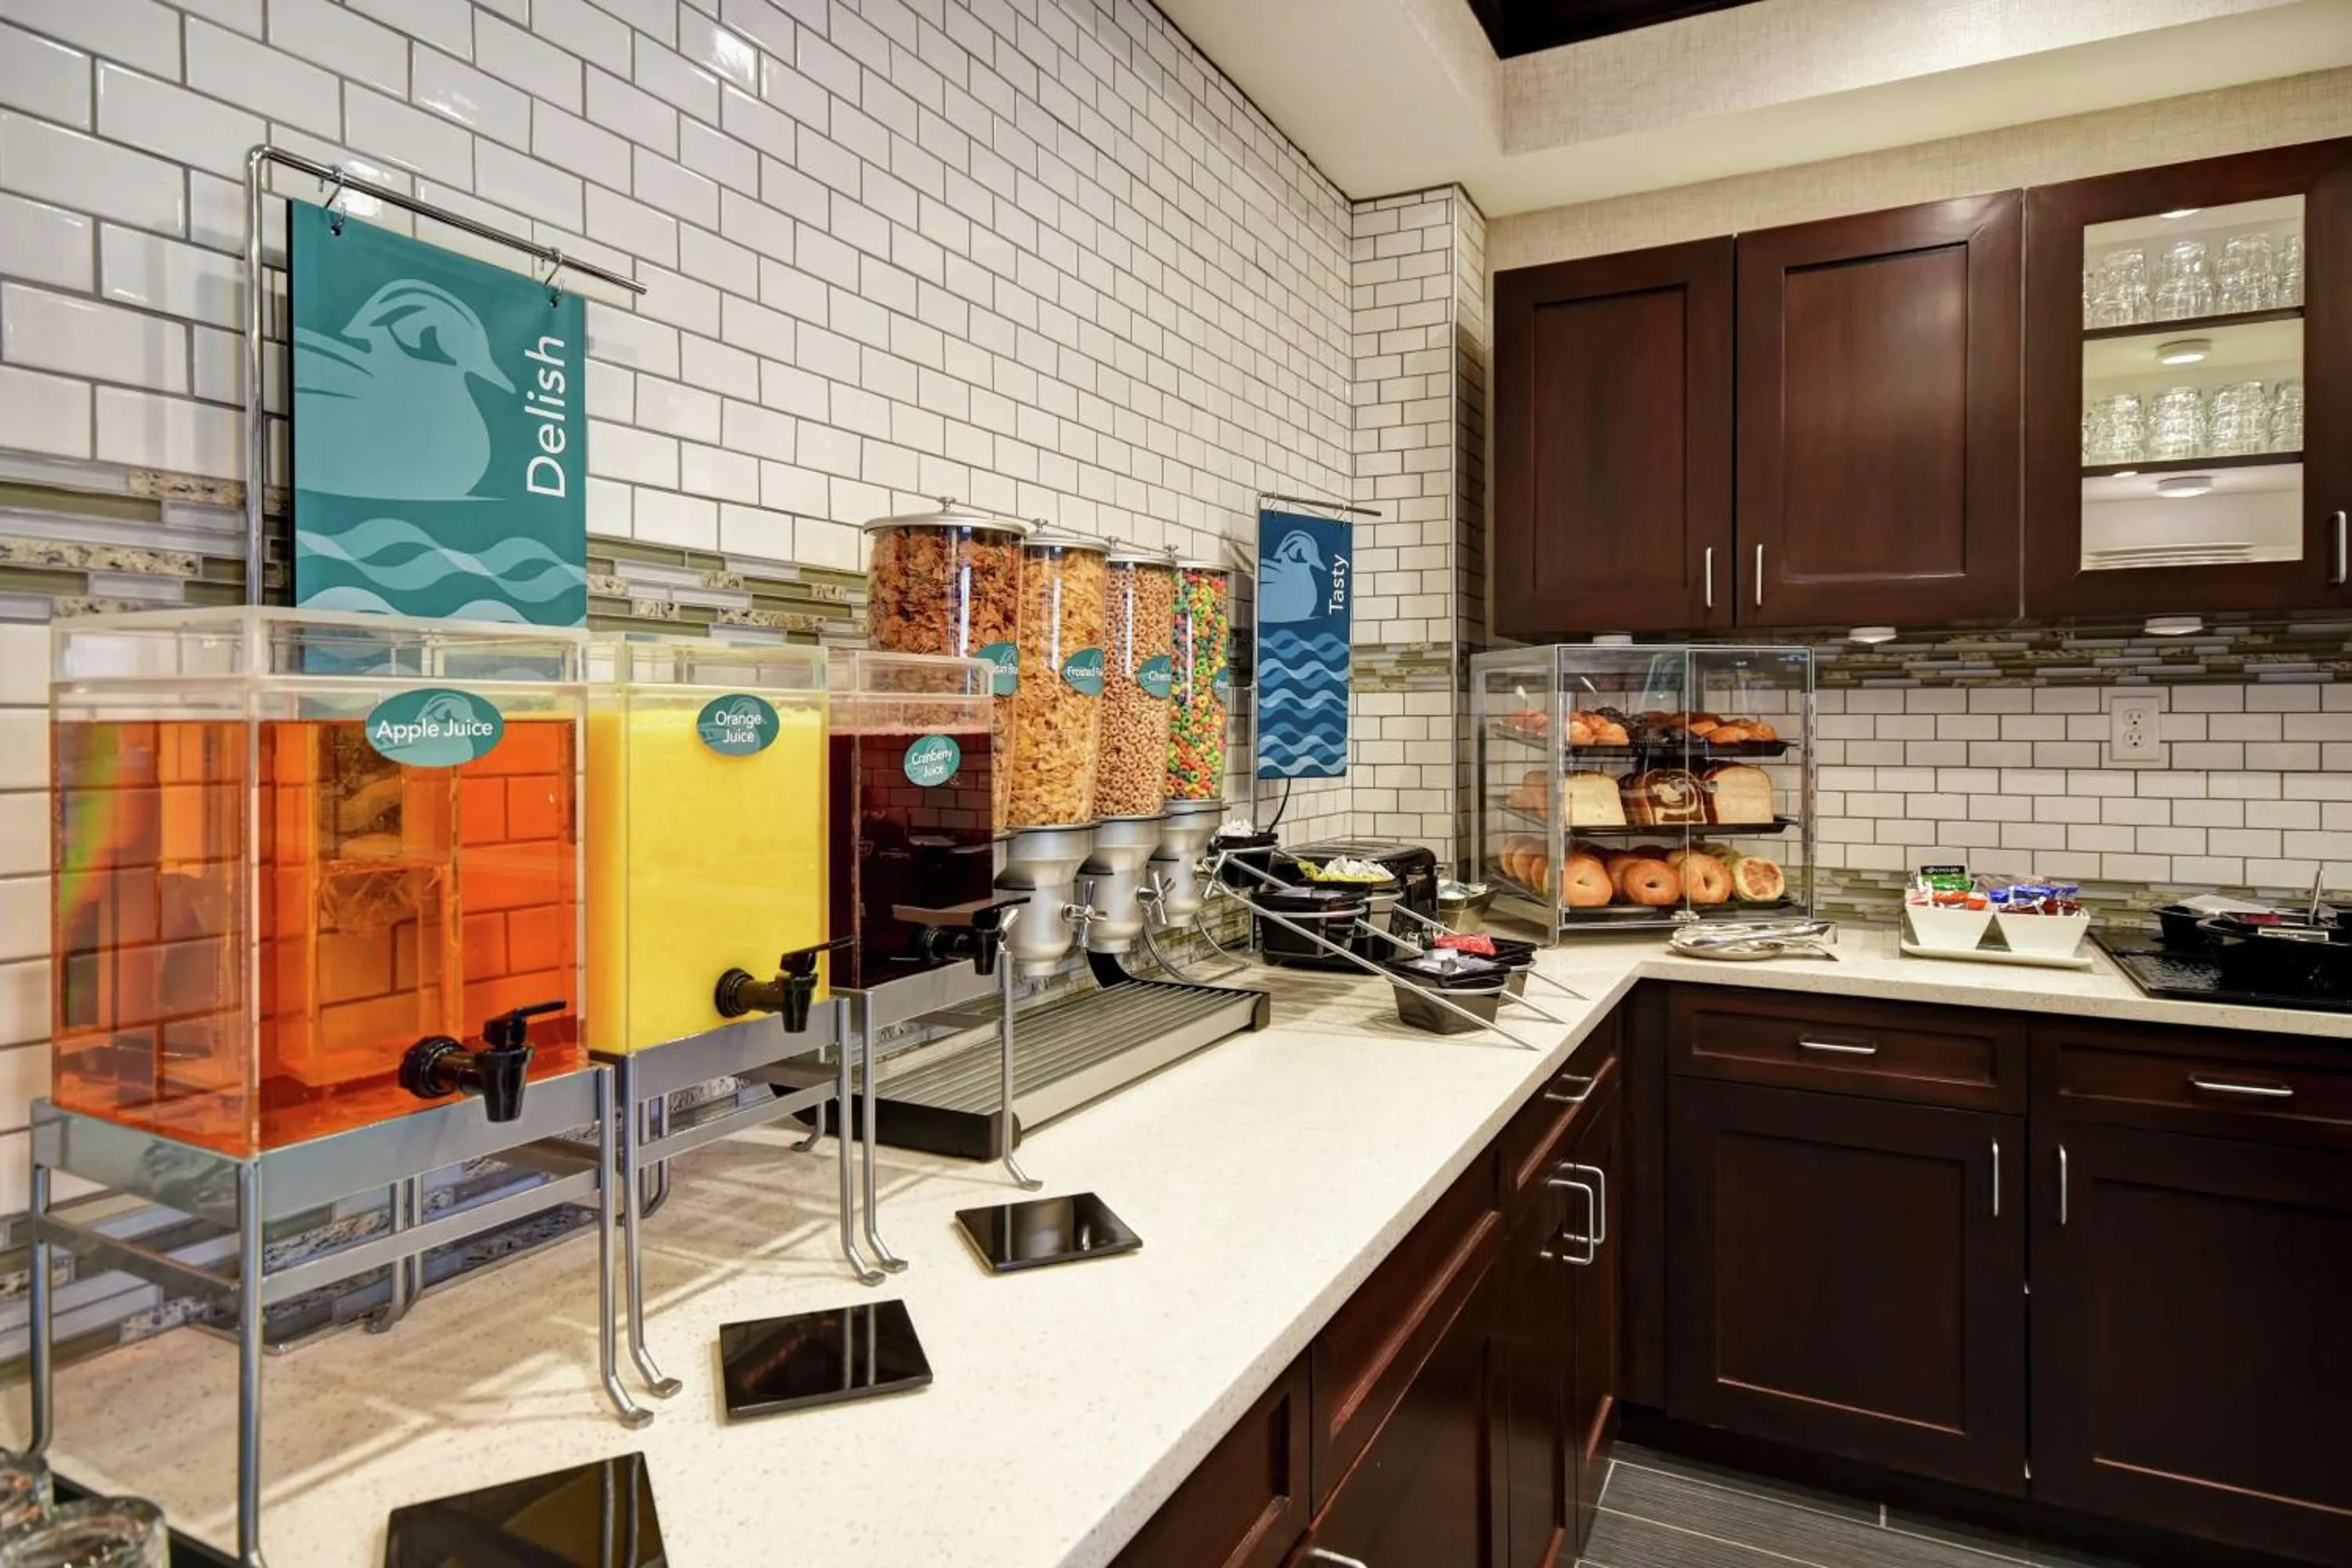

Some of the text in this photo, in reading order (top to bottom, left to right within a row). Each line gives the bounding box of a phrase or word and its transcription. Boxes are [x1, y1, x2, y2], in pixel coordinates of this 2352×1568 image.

[524, 336, 566, 498] Delish
[1329, 554, 1349, 615] Tasty
[715, 710, 761, 728] Orange
[376, 719, 493, 743] Apple Juice
[723, 728, 755, 743] Juice
[912, 749, 953, 765] Cranberry
